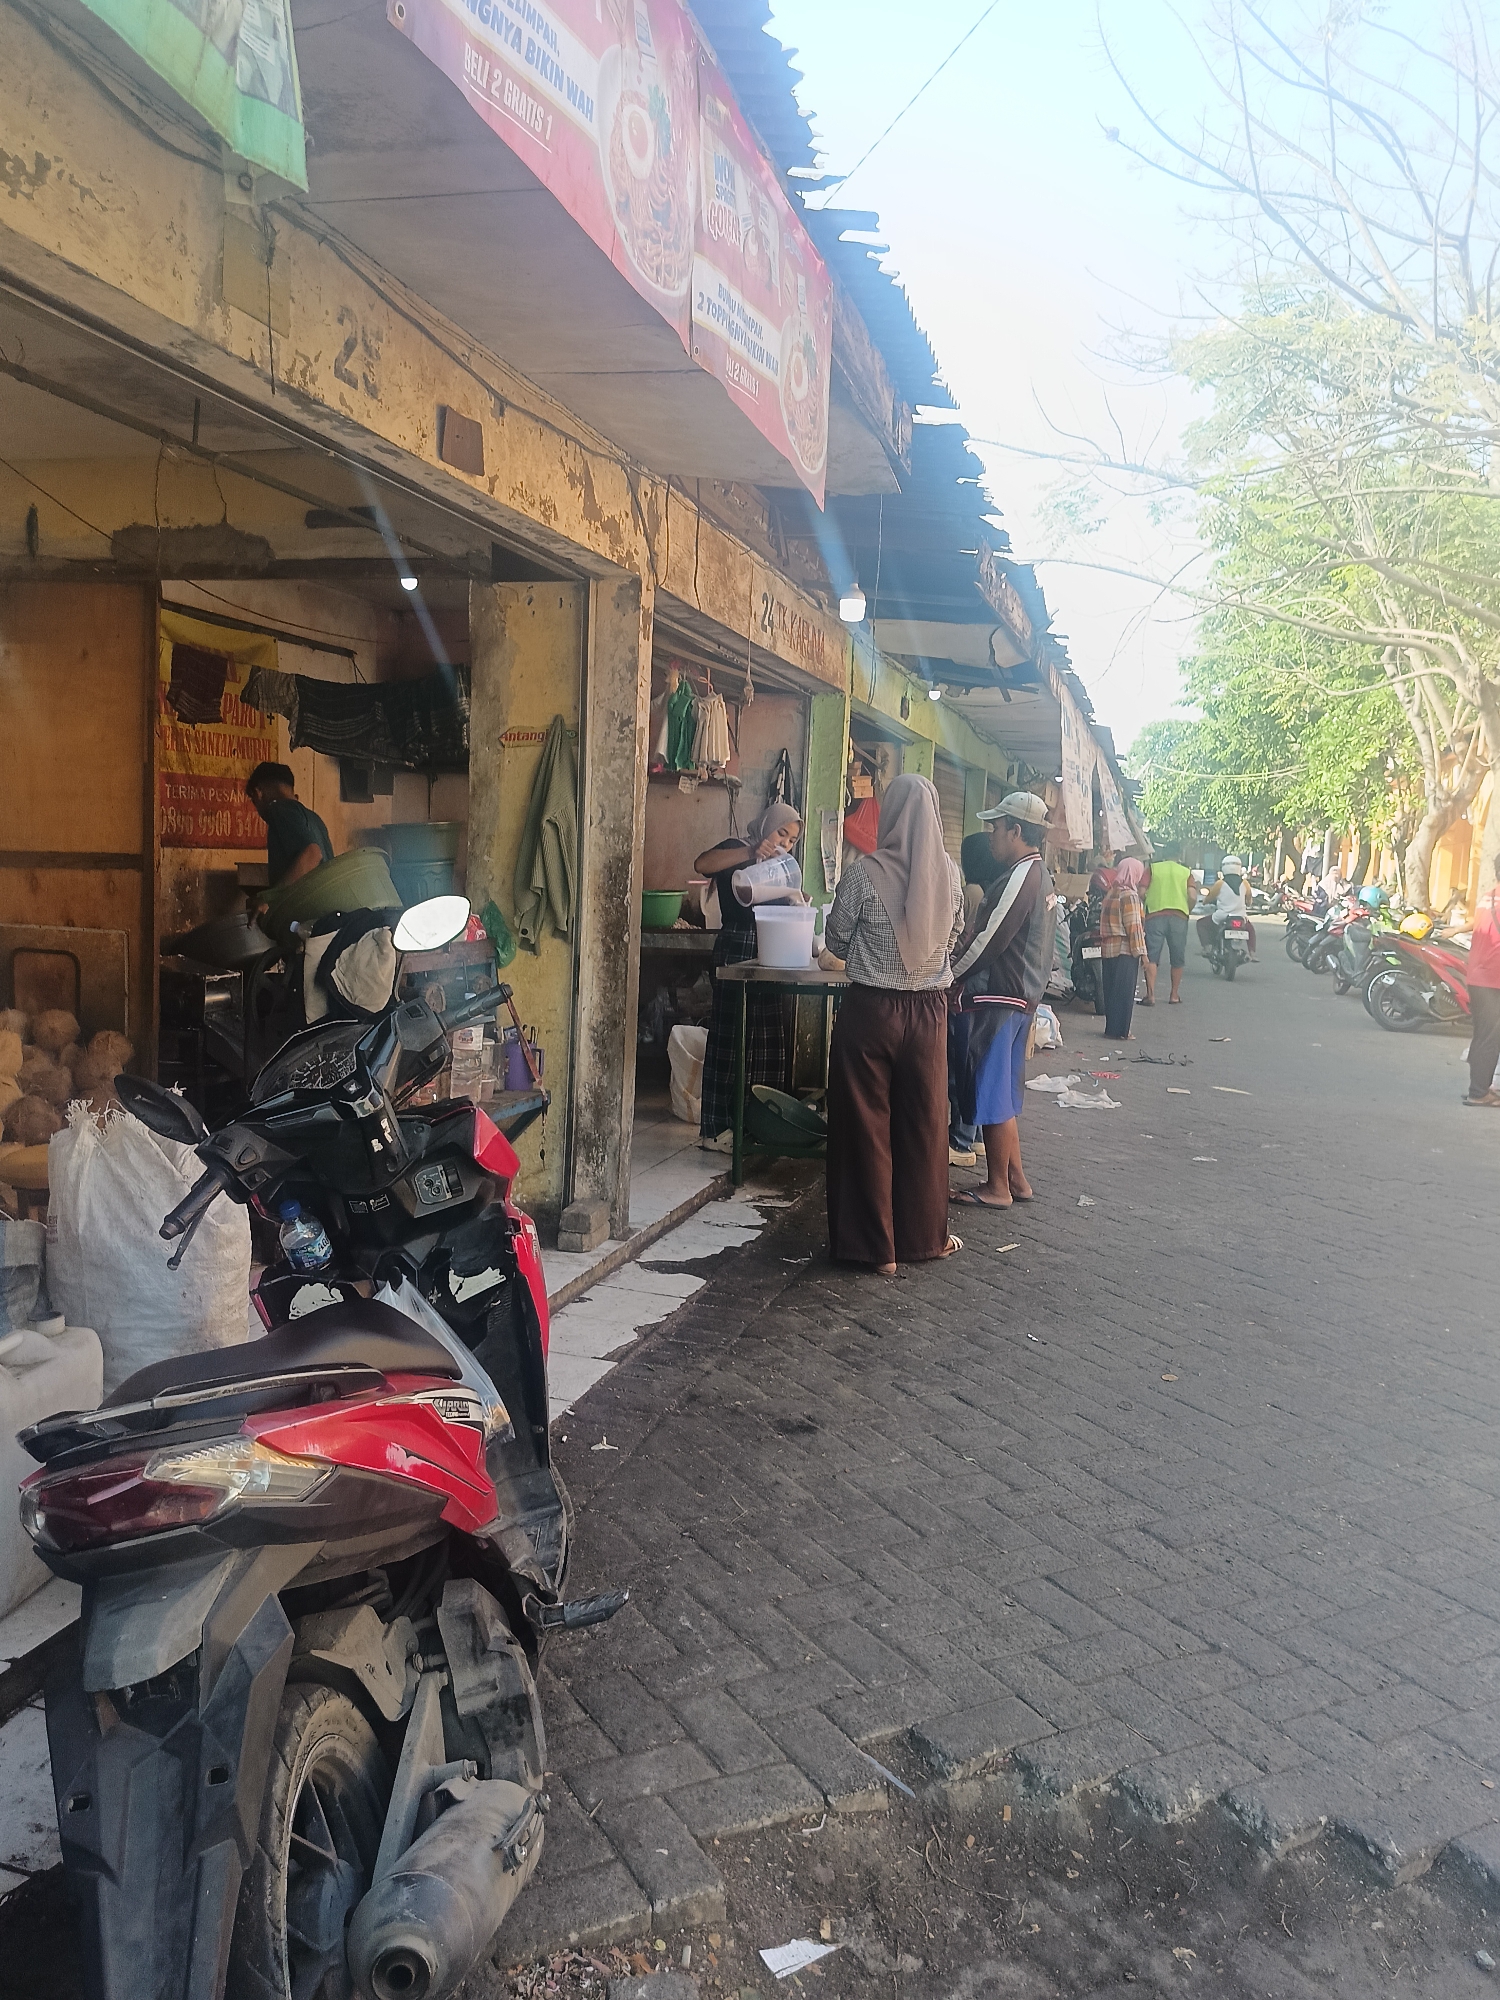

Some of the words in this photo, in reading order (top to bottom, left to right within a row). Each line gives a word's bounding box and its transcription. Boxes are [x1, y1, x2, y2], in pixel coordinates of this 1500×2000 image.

[464, 42, 490, 89] BELI
[491, 68, 503, 99] 2
[503, 78, 545, 133] GRATIS
[545, 114, 553, 141] 1
[525, 37, 565, 92] BIKIN
[567, 75, 594, 123] WAH
[697, 291, 705, 312] 2
[761, 592, 774, 637] 24
